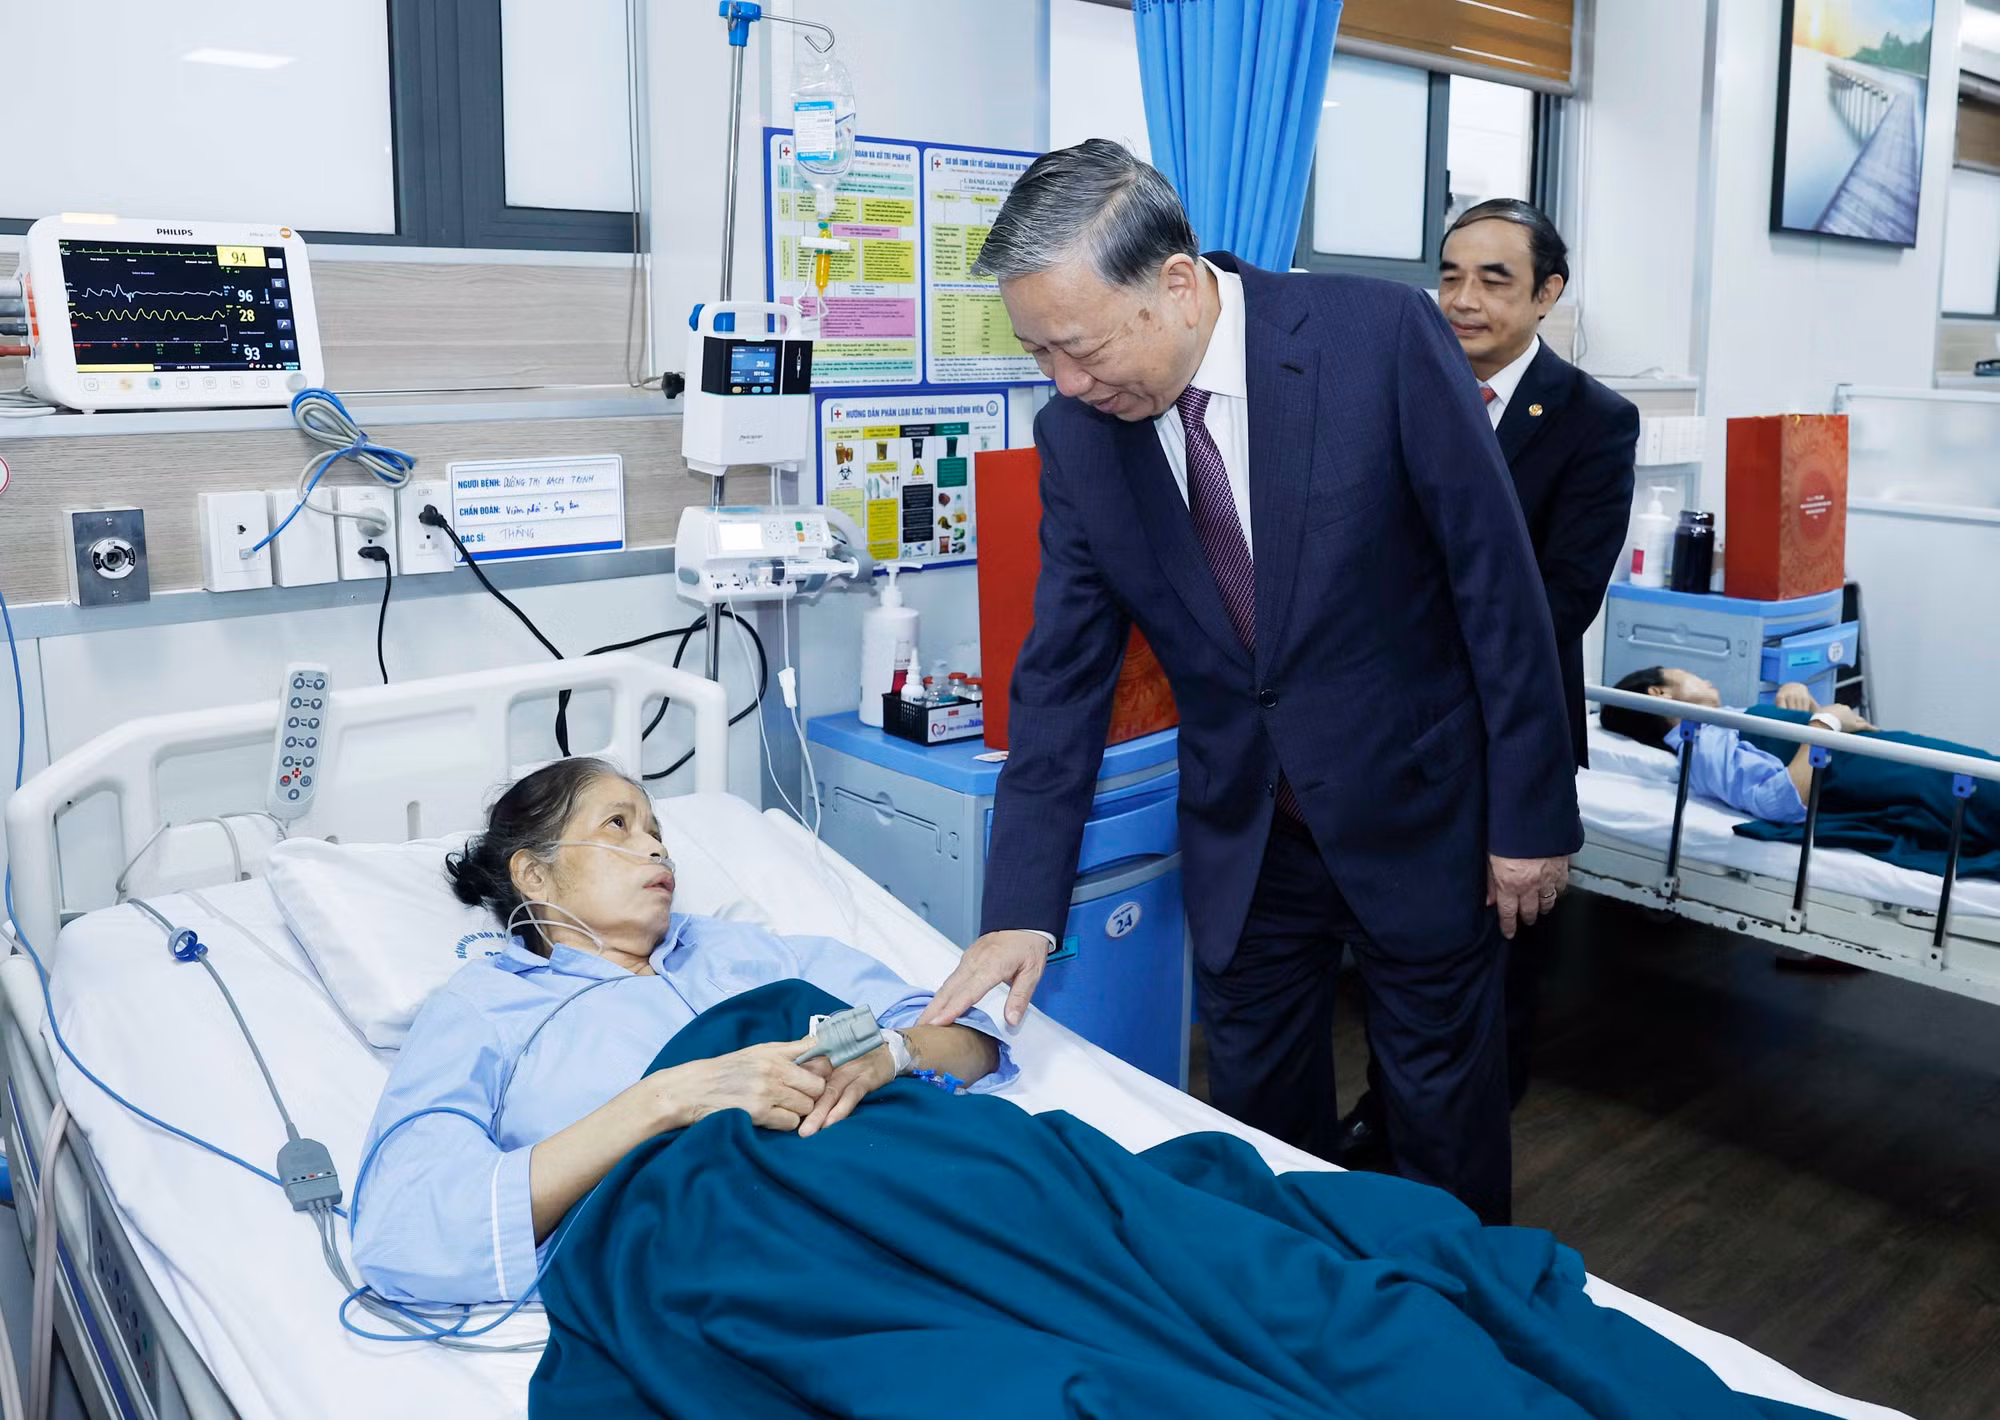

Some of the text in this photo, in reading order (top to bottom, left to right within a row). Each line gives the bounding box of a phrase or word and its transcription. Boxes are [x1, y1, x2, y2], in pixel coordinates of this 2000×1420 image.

[156, 228, 193, 236] PHILIPS
[231, 251, 247, 264] 94
[237, 289, 253, 302] 96
[239, 309, 255, 322] 28
[244, 347, 260, 360] 93
[1115, 911, 1134, 935] 24
